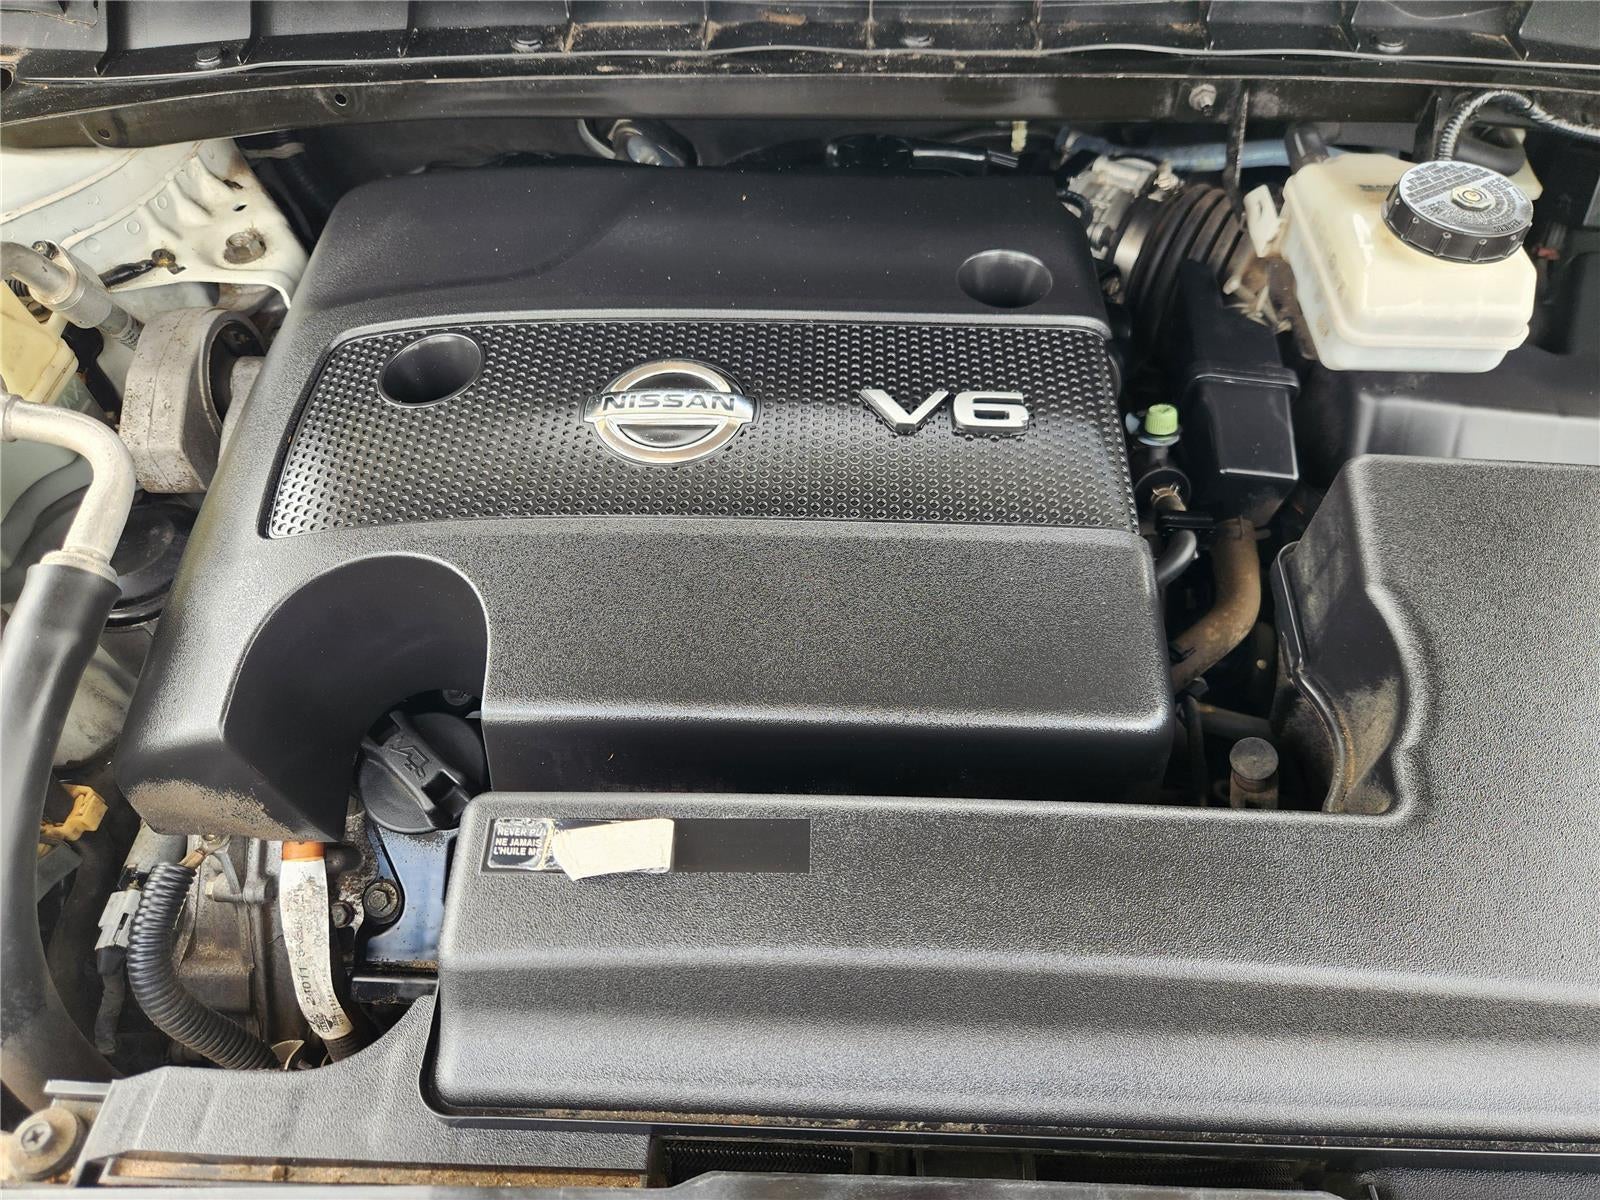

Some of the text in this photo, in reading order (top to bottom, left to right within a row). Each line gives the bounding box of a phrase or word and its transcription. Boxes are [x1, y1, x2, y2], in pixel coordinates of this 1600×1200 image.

[602, 393, 736, 412] NISSAN
[858, 388, 1029, 435] V6
[496, 826, 527, 836] NEVER
[495, 837, 543, 847] NE JAMAIS
[493, 846, 527, 856] L'HUILE
